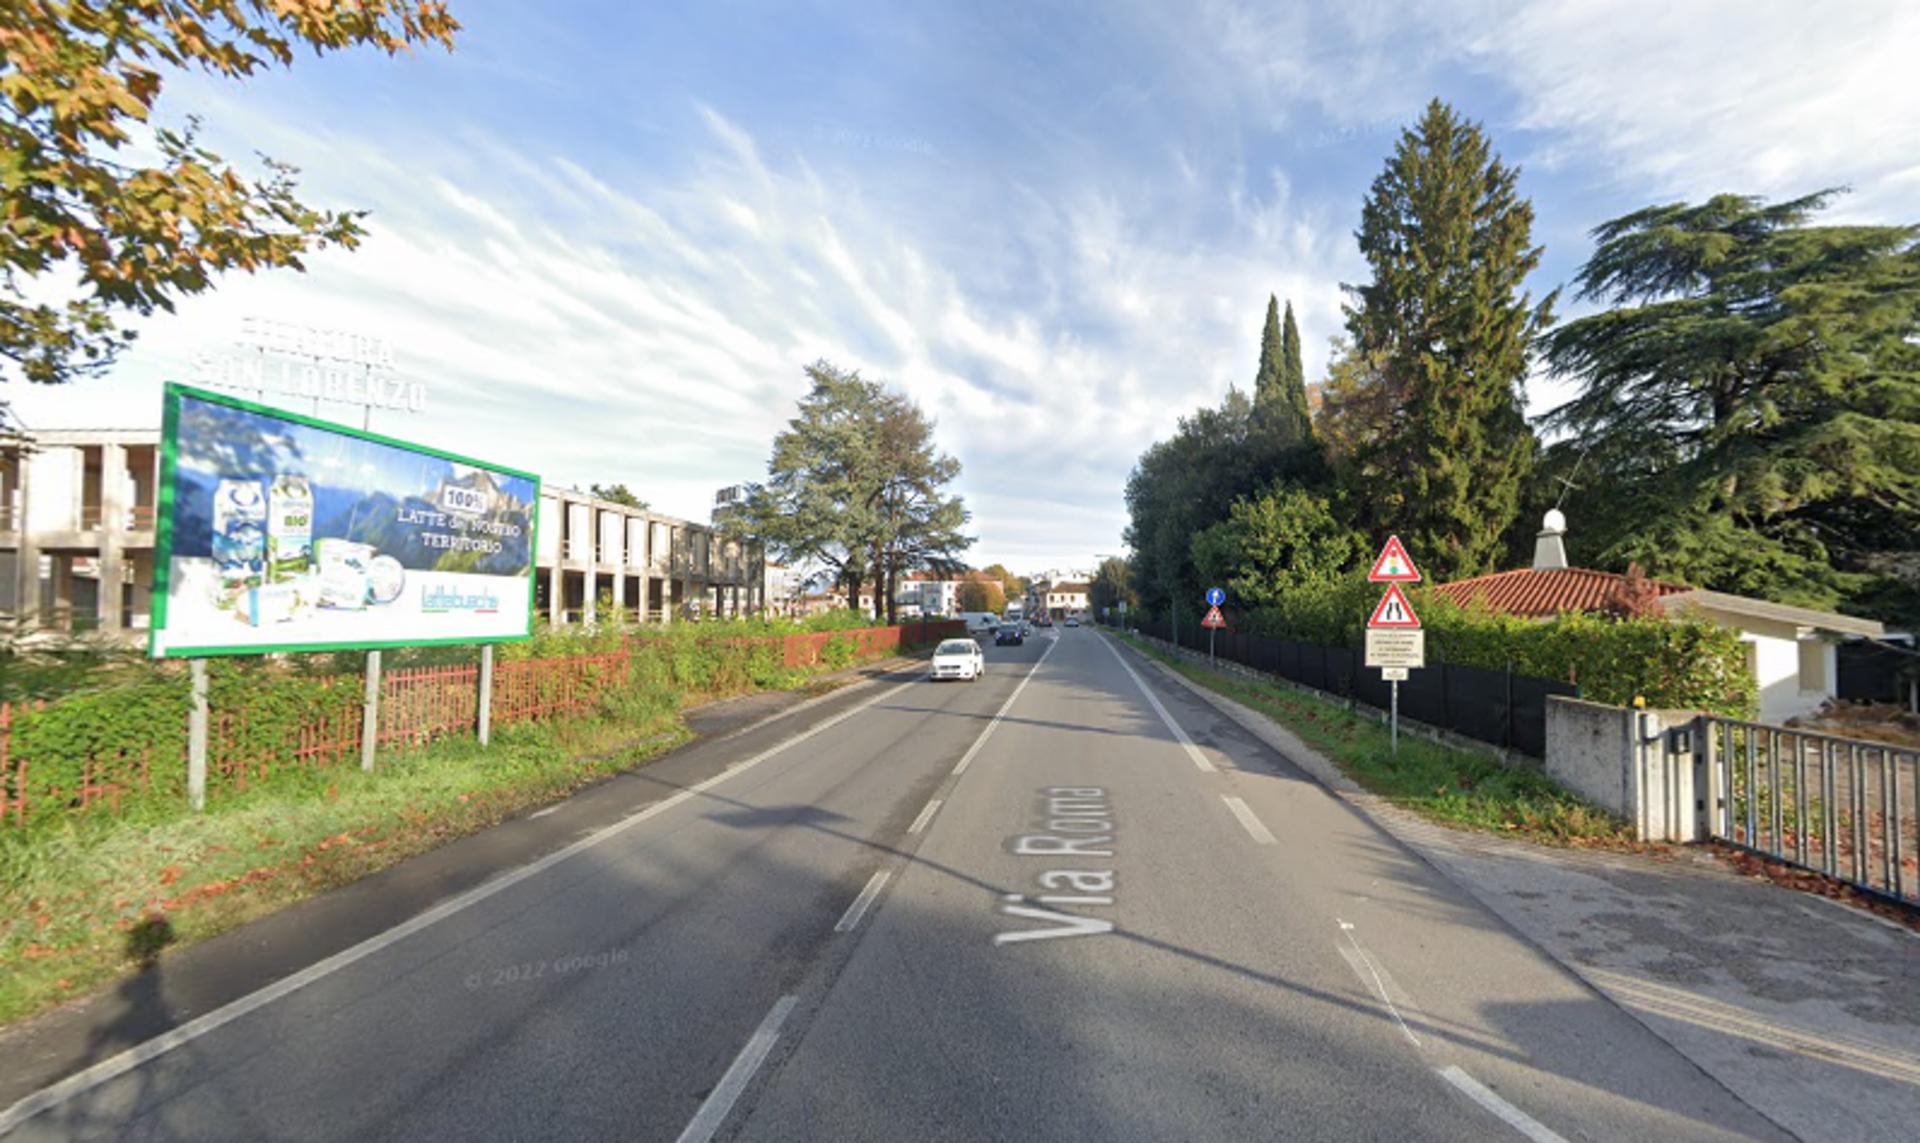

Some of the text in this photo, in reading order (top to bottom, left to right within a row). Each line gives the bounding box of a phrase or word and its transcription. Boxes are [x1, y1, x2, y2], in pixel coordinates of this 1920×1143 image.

[281, 361, 427, 412] LORENZO
[447, 489, 483, 508] 100%
[284, 514, 309, 527] BIO
[397, 508, 447, 527] LATTE
